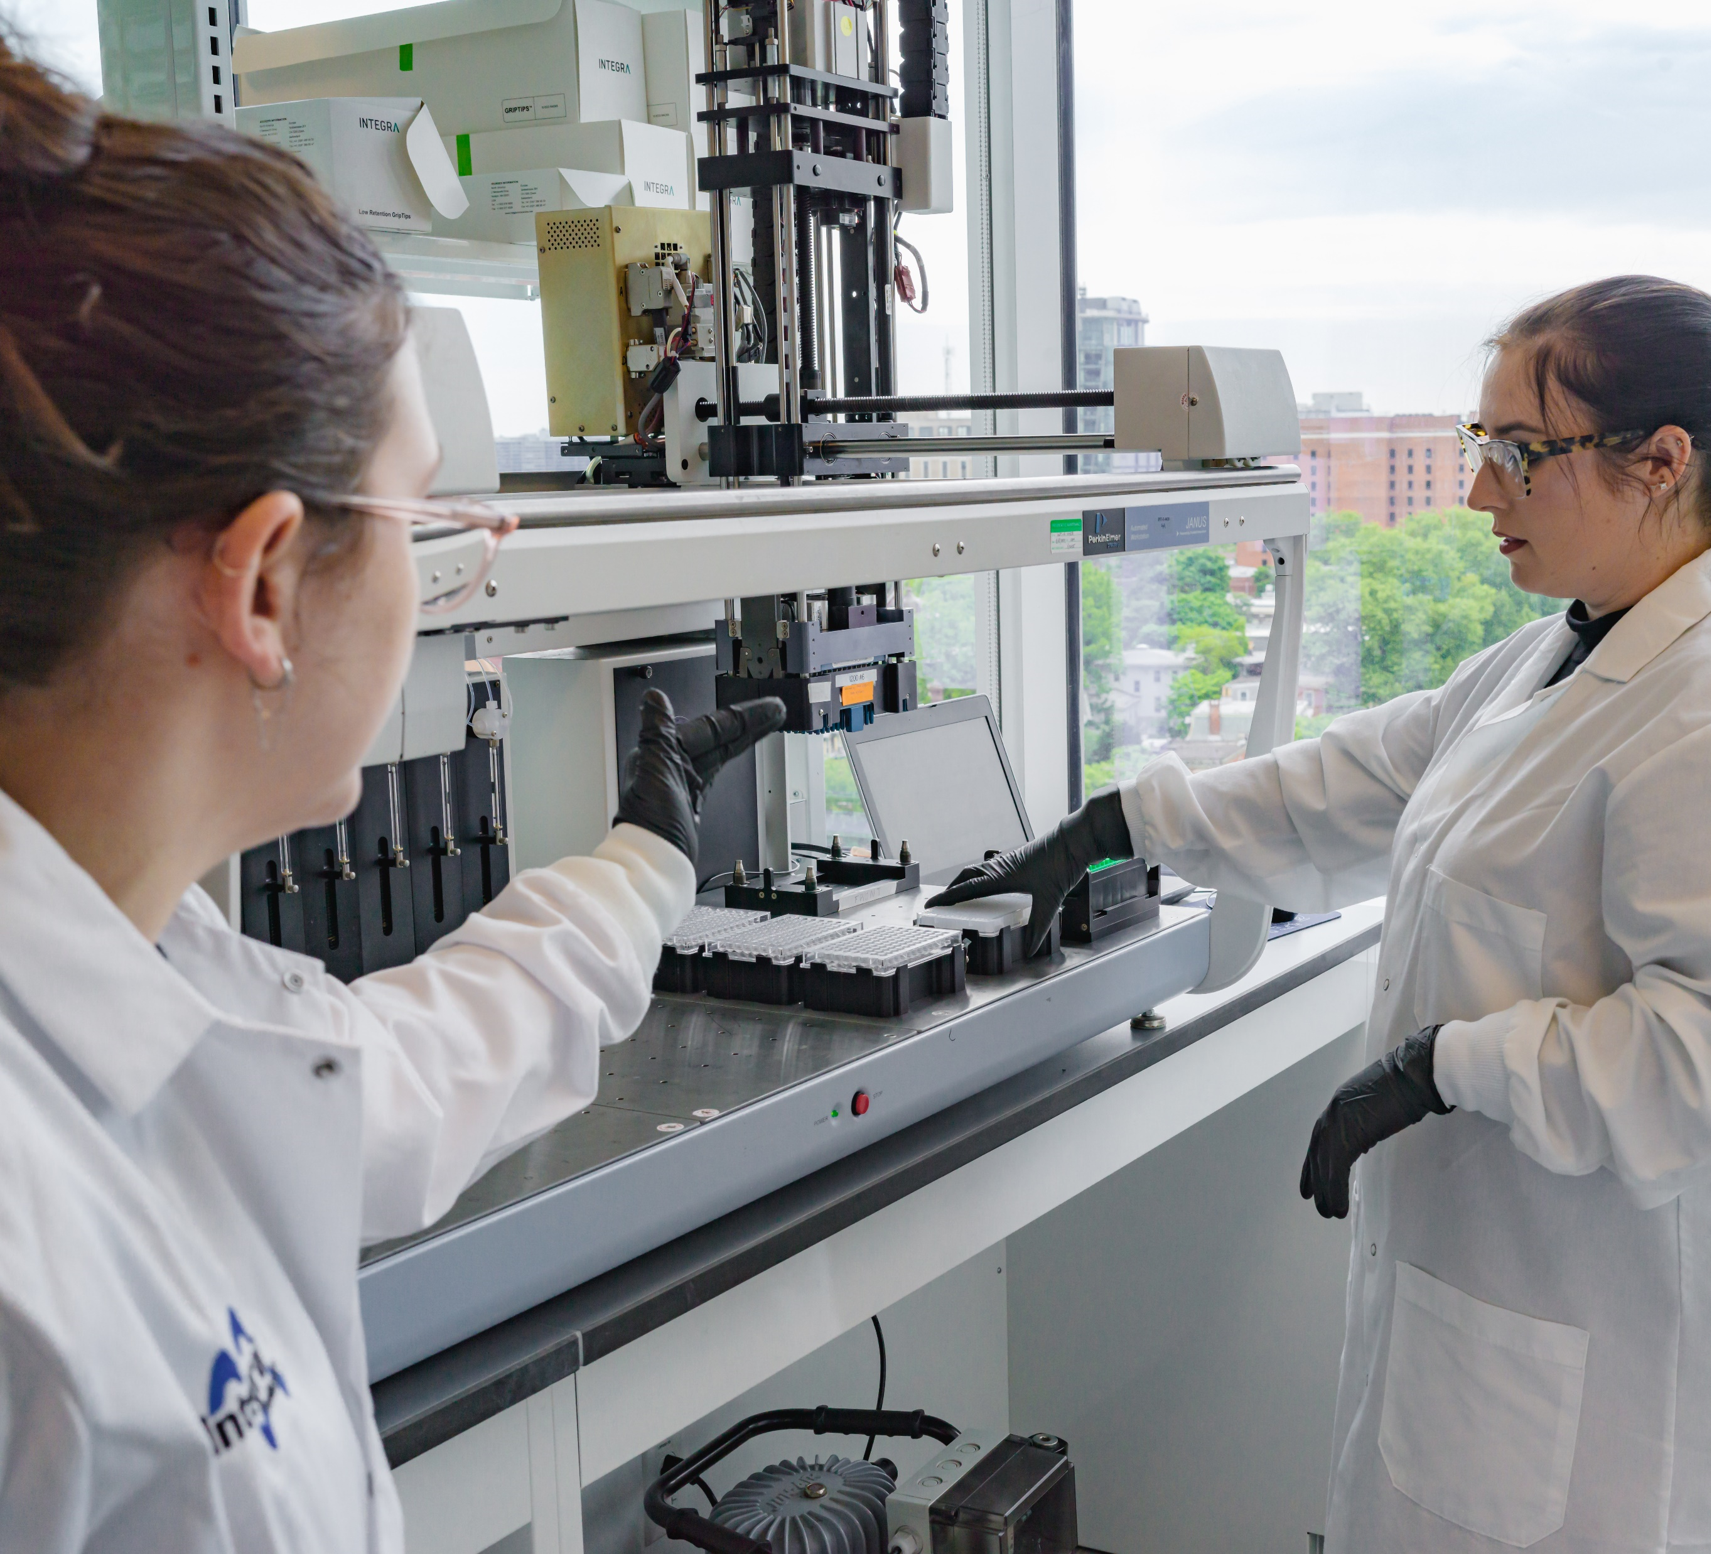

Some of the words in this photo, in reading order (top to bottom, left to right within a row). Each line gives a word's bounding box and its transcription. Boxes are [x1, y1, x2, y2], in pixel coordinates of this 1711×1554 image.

[598, 58, 631, 75] INTEGRA
[359, 116, 400, 133] INTEGRA
[643, 180, 675, 196] INTEGRA
[369, 209, 391, 217] Retention
[1185, 515, 1207, 529] JANUS
[1088, 533, 1121, 544] PerkinElmer
[872, 1090, 884, 1100] STOP
[813, 1115, 829, 1126] POWER
